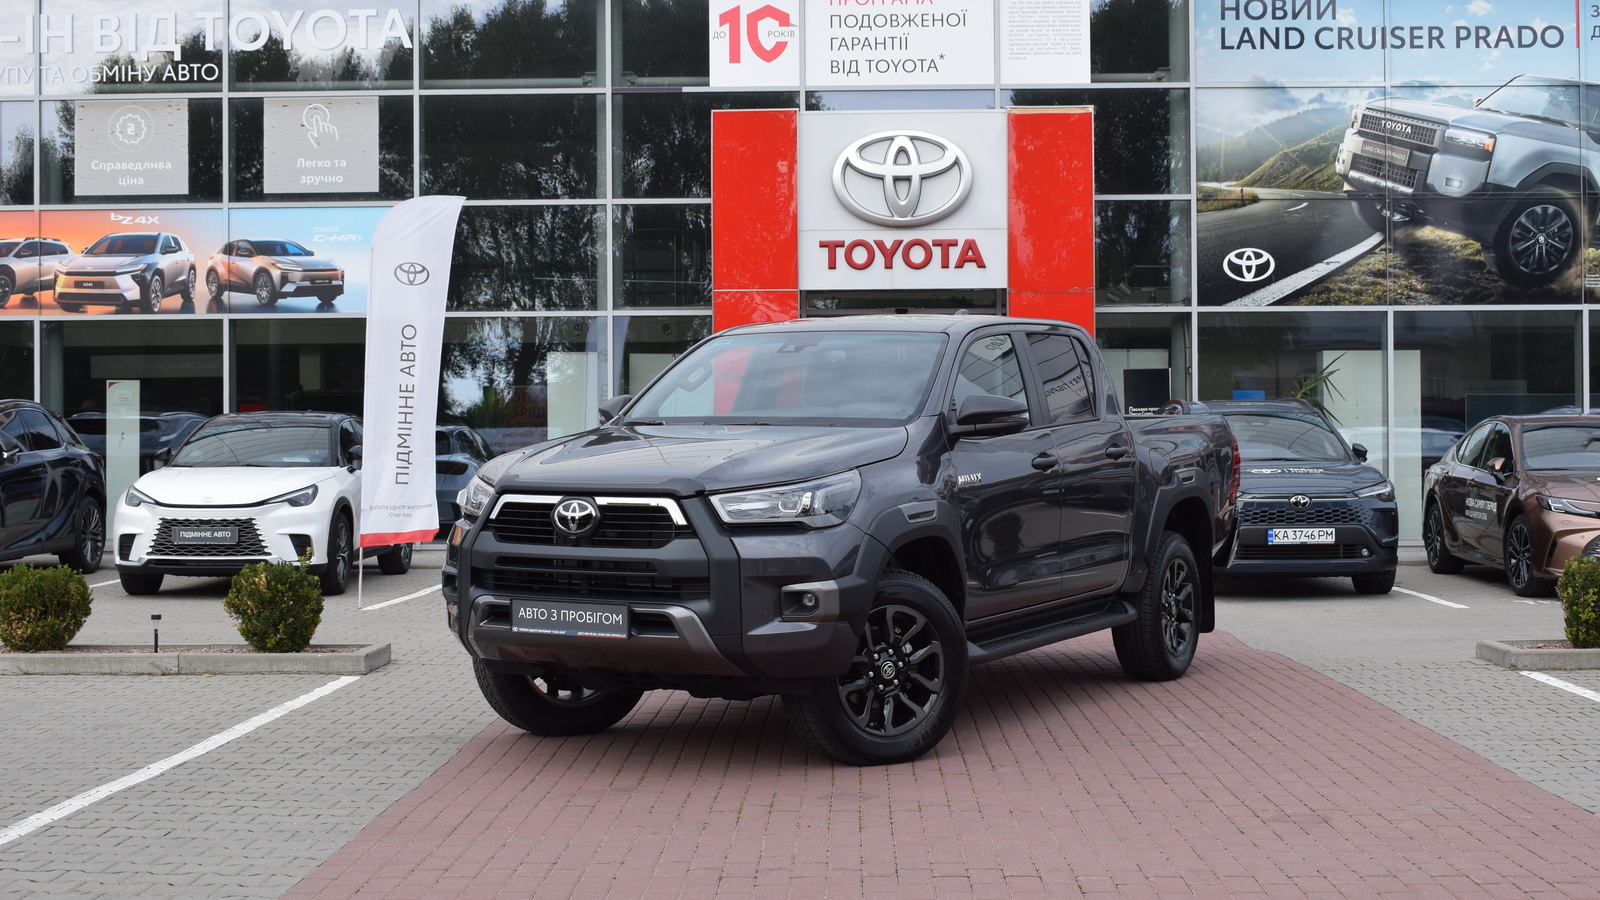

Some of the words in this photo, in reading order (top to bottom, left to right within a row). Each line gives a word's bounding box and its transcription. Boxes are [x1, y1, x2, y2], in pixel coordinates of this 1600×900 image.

[829, 9, 968, 31] ПОДОВЖЕНОЇ
[93, 12, 182, 62] ВІД
[195, 8, 413, 53] TOYOTA
[712, 31, 727, 39] ДО
[767, 30, 796, 38] РОКІВ
[829, 33, 909, 52] ГАРАНТІЇ
[1220, 26, 1305, 50] LAND
[1314, 25, 1446, 51] CRUISER
[1454, 24, 1565, 50] PRADO
[40, 66, 65, 83] ТА
[71, 64, 157, 84] ОБМІНУ
[162, 63, 219, 82] АВТО
[829, 58, 861, 77] ВІД
[1381, 119, 1412, 134] TOYOTA
[91, 159, 172, 173] Справедлива
[296, 157, 332, 169] Легко
[334, 159, 347, 168] та
[118, 174, 145, 187] ціна
[299, 173, 344, 186] зручно
[818, 238, 987, 270] TOYOTA
[400, 323, 418, 378] АВТО
[395, 382, 415, 486] ПІДМІННЕ
[958, 472, 982, 485] HILUX
[1274, 530, 1290, 541] KA
[1292, 530, 1316, 541] 3746
[1317, 529, 1334, 540] PM
[518, 607, 548, 620] АВТО
[550, 609, 558, 621] З
[561, 609, 623, 626] ПРОБІГОМ
